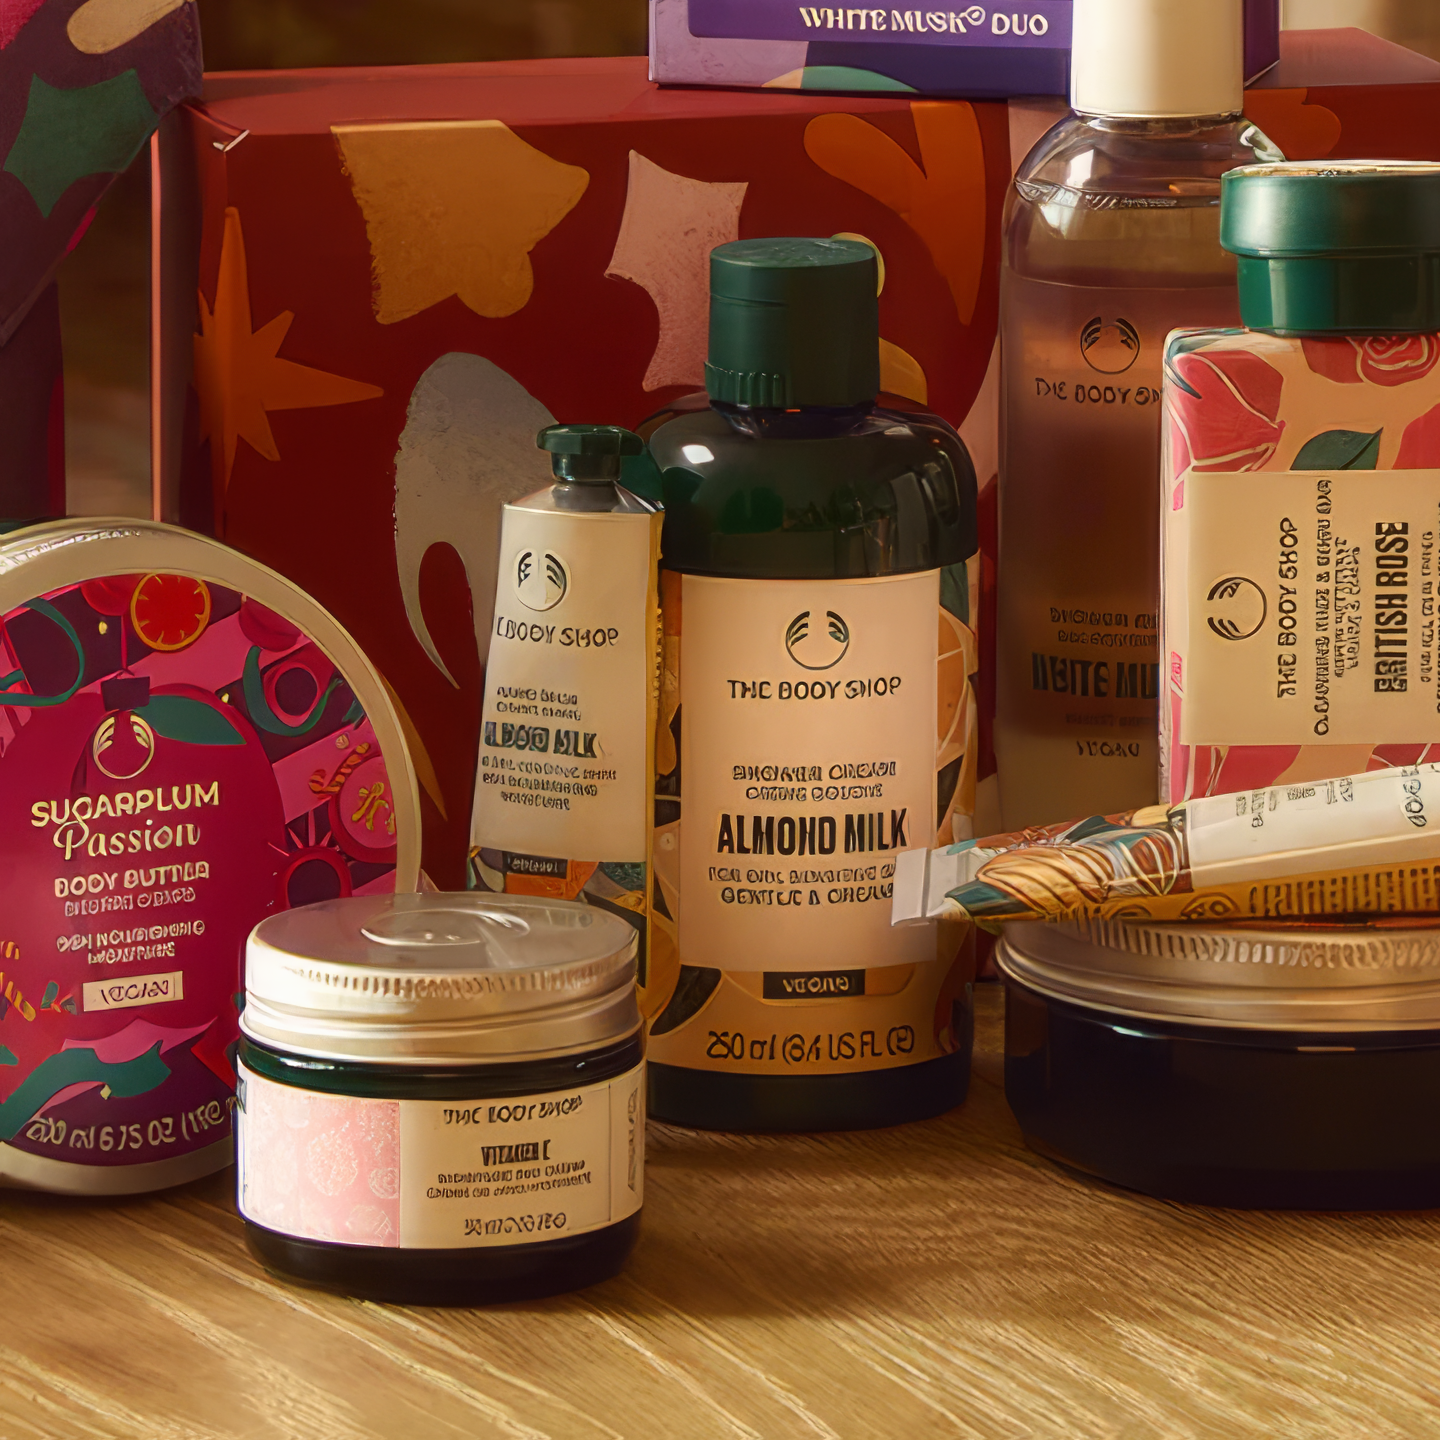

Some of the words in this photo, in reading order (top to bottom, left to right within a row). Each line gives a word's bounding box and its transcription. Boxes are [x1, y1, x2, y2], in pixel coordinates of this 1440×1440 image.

[799, 7, 887, 33] WHITE
[991, 13, 1048, 36] DUO
[1375, 522, 1409, 586] ROSE
[1277, 586, 1298, 647] BODY
[1374, 594, 1408, 693] BRITISH
[728, 679, 771, 700] THE
[778, 680, 841, 701] BODY
[31, 781, 219, 827] SUGARPLUM
[53, 819, 200, 860] Passion
[717, 813, 840, 856] ALMOND
[843, 808, 909, 852] MILK
[55, 872, 118, 898] BODY
[860, 1028, 884, 1058] FL
